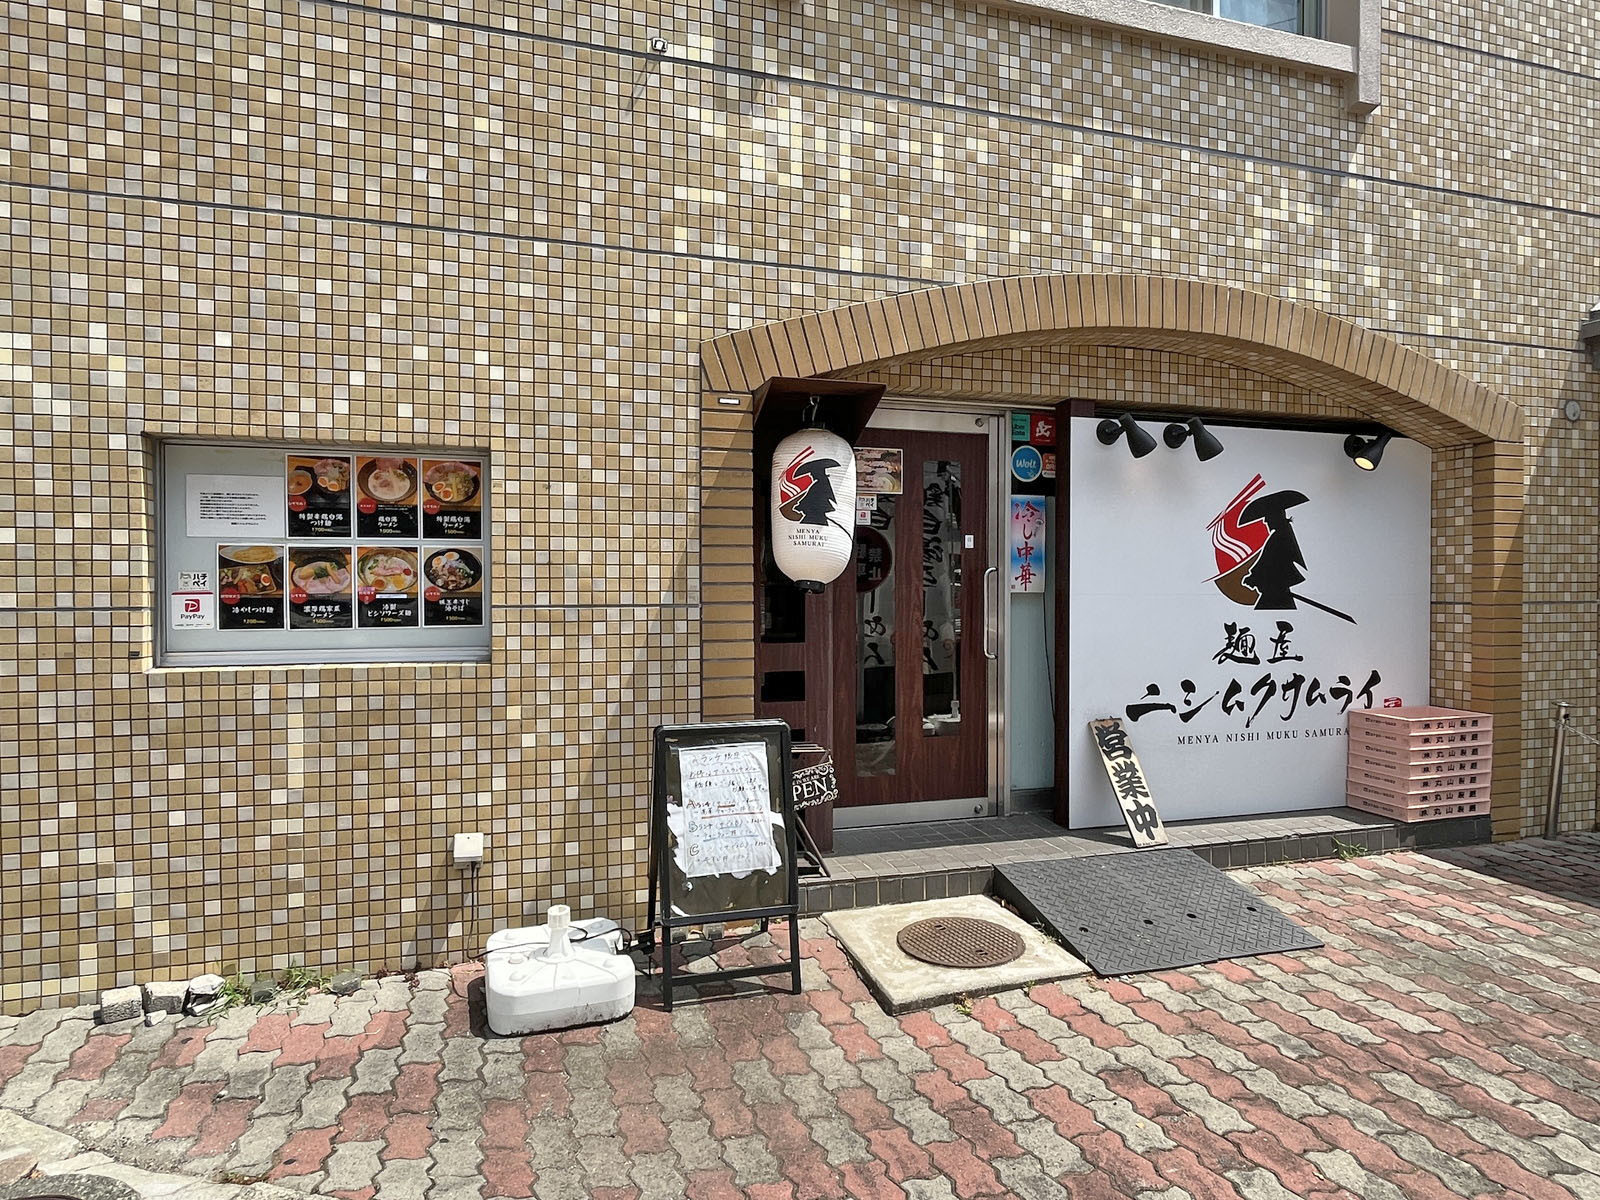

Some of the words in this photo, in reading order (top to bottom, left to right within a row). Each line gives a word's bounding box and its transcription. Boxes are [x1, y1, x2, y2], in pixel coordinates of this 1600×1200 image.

[1016, 458, 1036, 468] Wolt
[1014, 500, 1040, 592] 冷し中華
[1212, 620, 1304, 665] 麺屋
[1126, 670, 1382, 728] ニシムクサムライ
[1178, 734, 1219, 744] MENYA
[1226, 732, 1260, 742] NISHI
[1267, 730, 1298, 740] MUKU
[1304, 728, 1349, 738] SAMURA
[792, 776, 828, 801] PEN
[1094, 722, 1159, 840] 営業中
